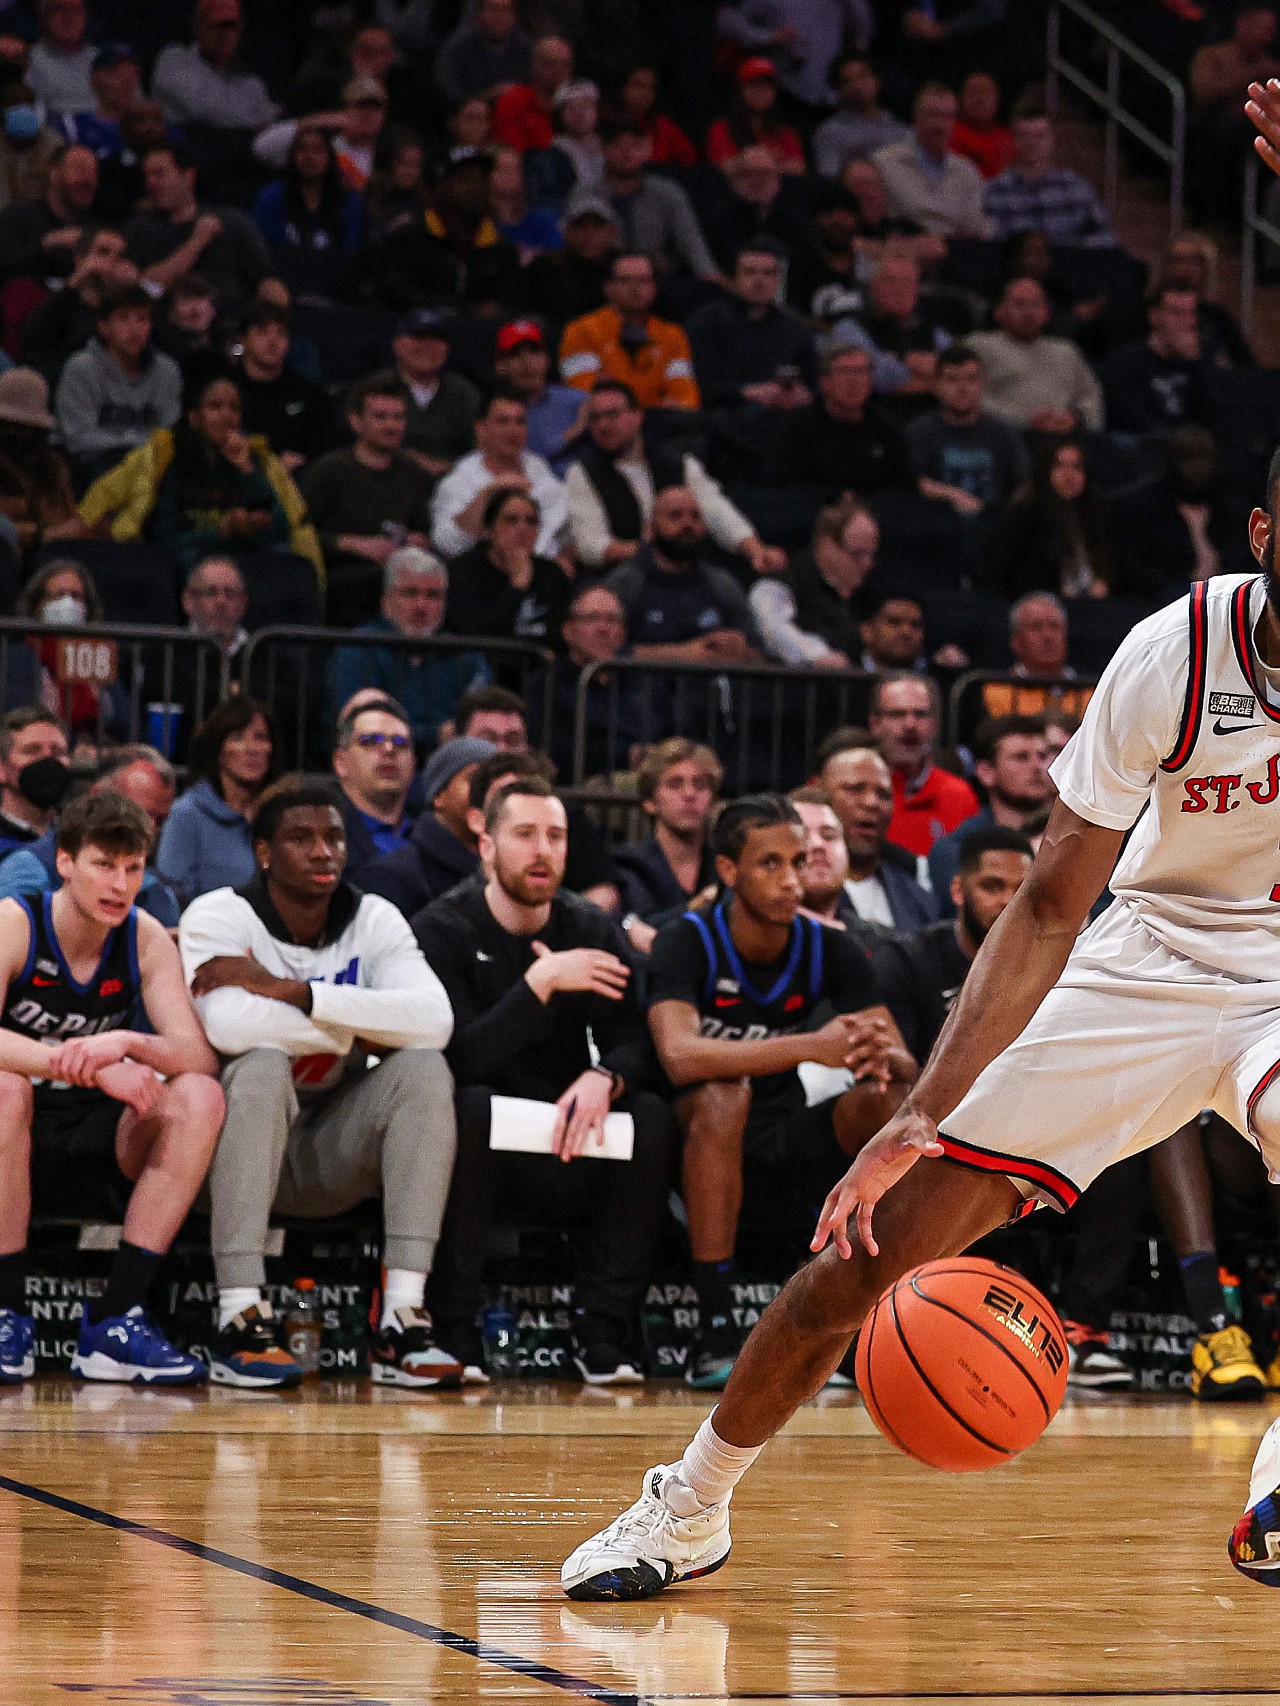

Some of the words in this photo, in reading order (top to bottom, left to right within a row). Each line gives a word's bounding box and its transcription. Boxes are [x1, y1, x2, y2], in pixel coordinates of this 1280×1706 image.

[1210, 704, 1253, 715] CHANGE
[1180, 774, 1243, 815] ST.
[983, 1284, 1064, 1376] ELITE
